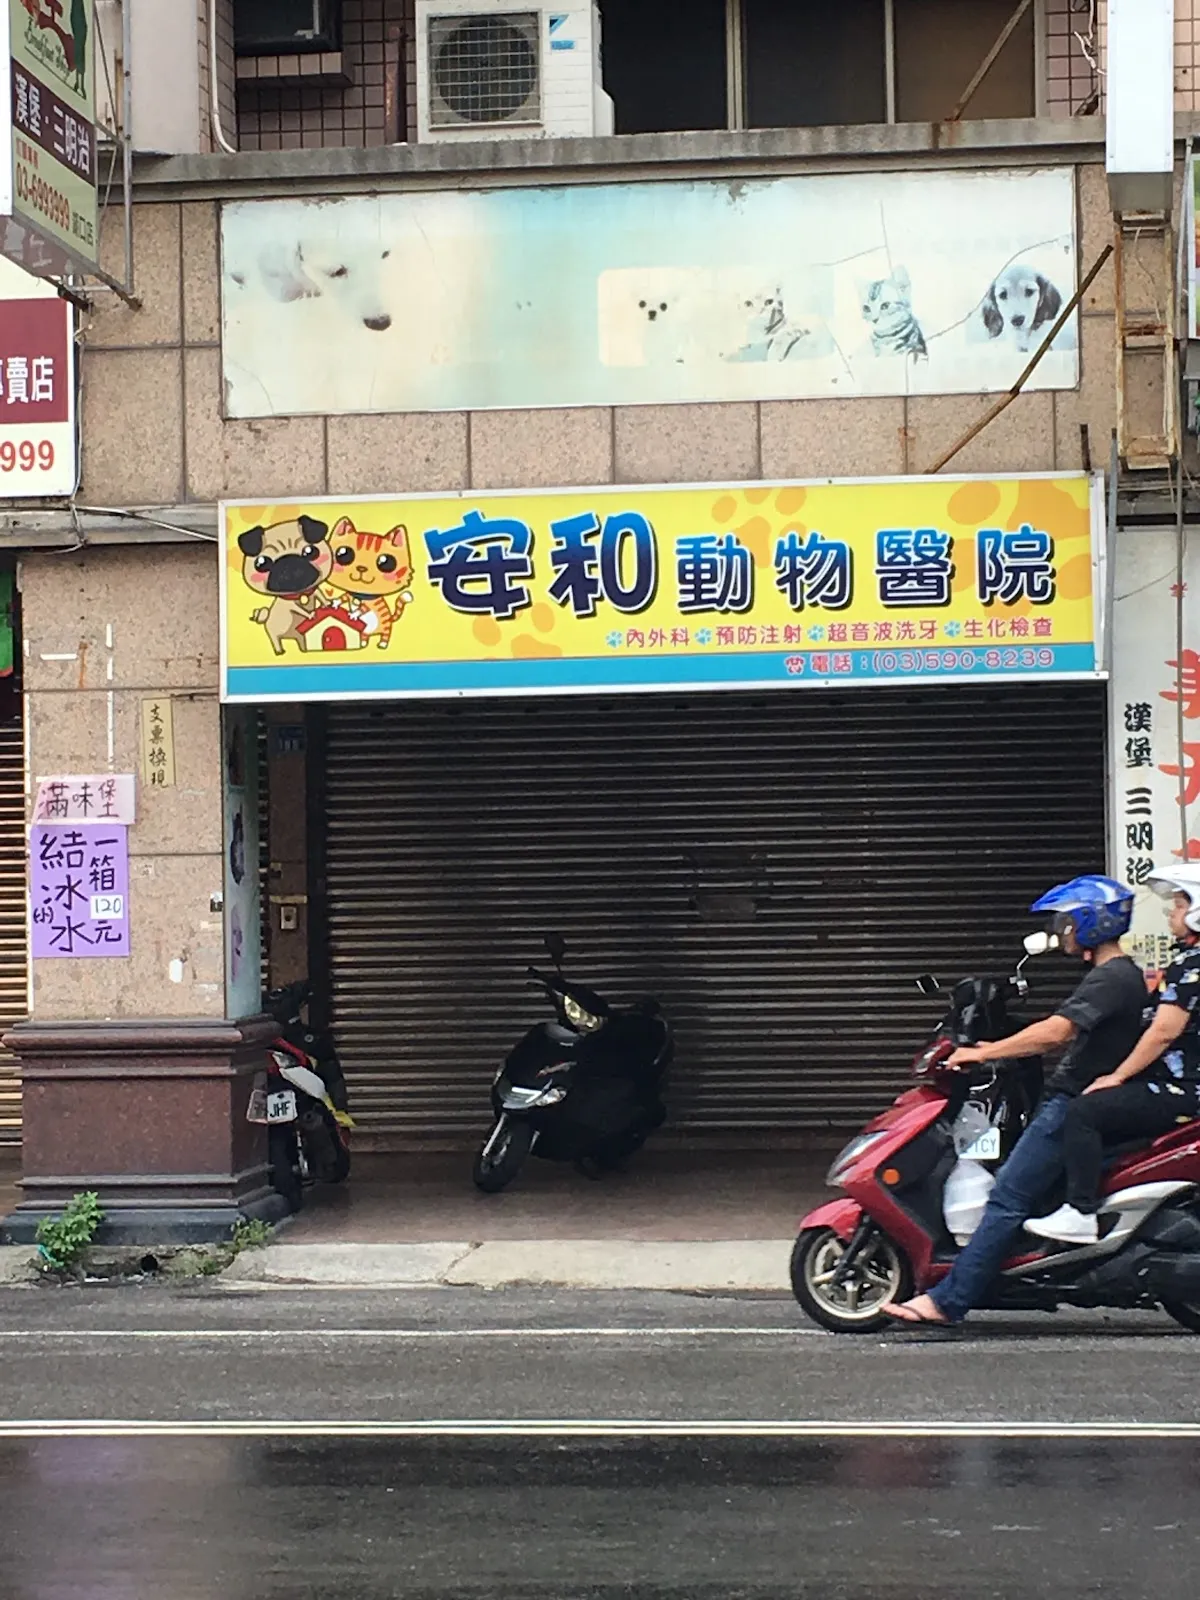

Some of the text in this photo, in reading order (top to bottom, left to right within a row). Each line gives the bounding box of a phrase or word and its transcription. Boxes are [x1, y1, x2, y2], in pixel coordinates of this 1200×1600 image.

[0, 356, 54, 404] 賣店
[423, 509, 1056, 620] 安和動物醫院
[626, 616, 1053, 648] 內外科 預防注射 超音波洗牙 生化檢查
